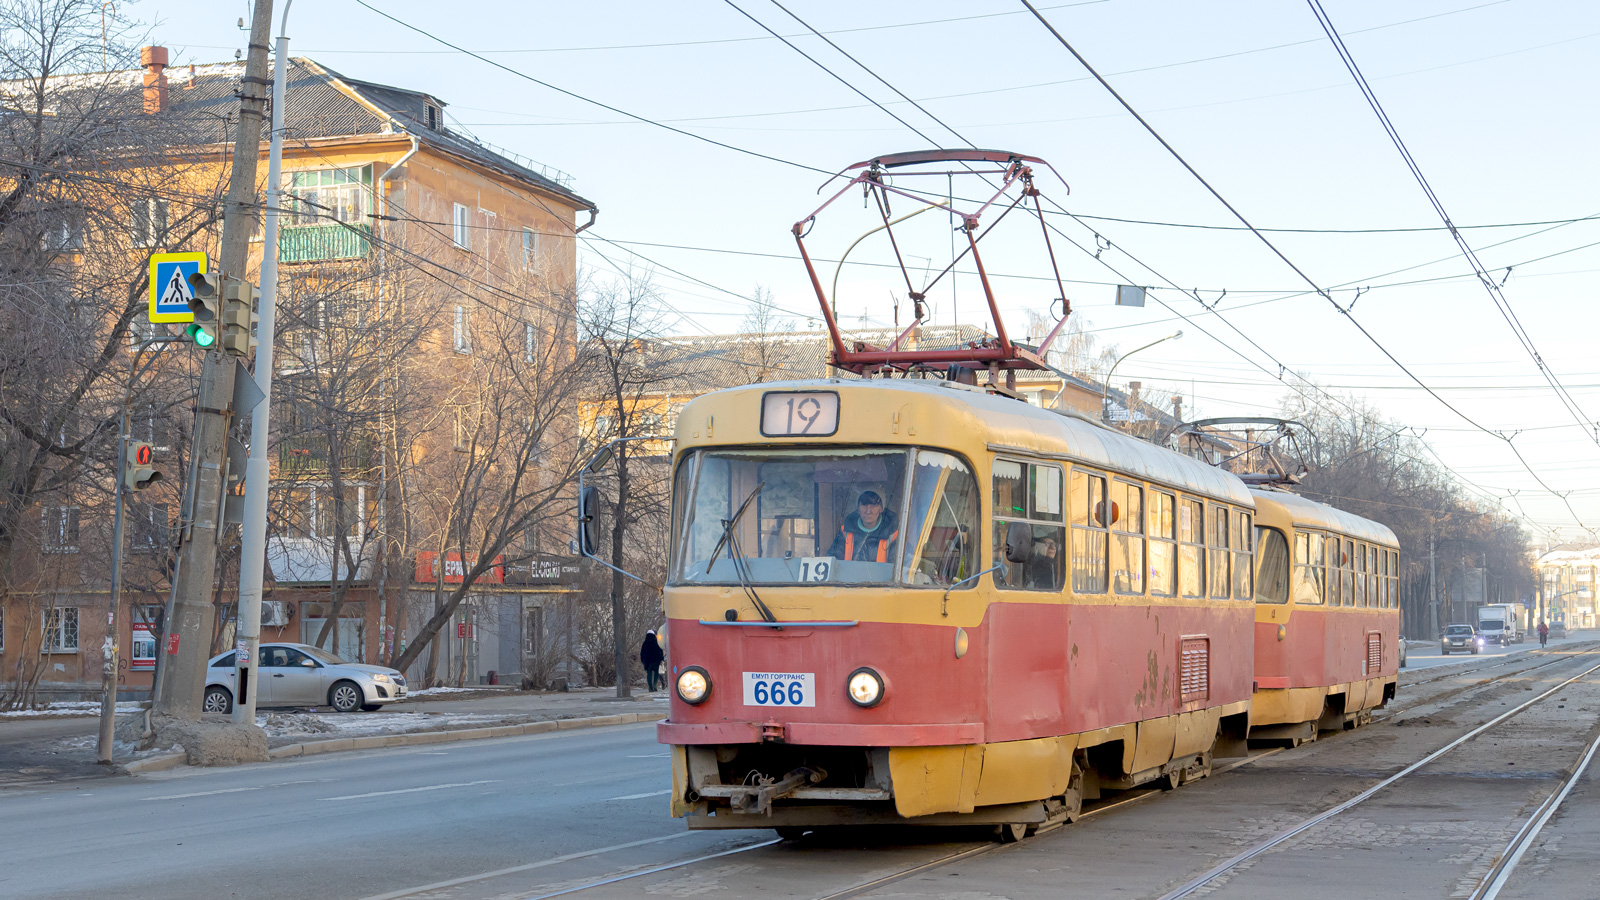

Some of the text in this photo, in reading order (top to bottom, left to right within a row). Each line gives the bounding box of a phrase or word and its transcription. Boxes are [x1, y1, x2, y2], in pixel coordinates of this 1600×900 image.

[786, 397, 821, 435] 19
[802, 561, 830, 582] 19
[770, 673, 806, 681] ГОРТРАНС
[754, 680, 804, 705] 666
